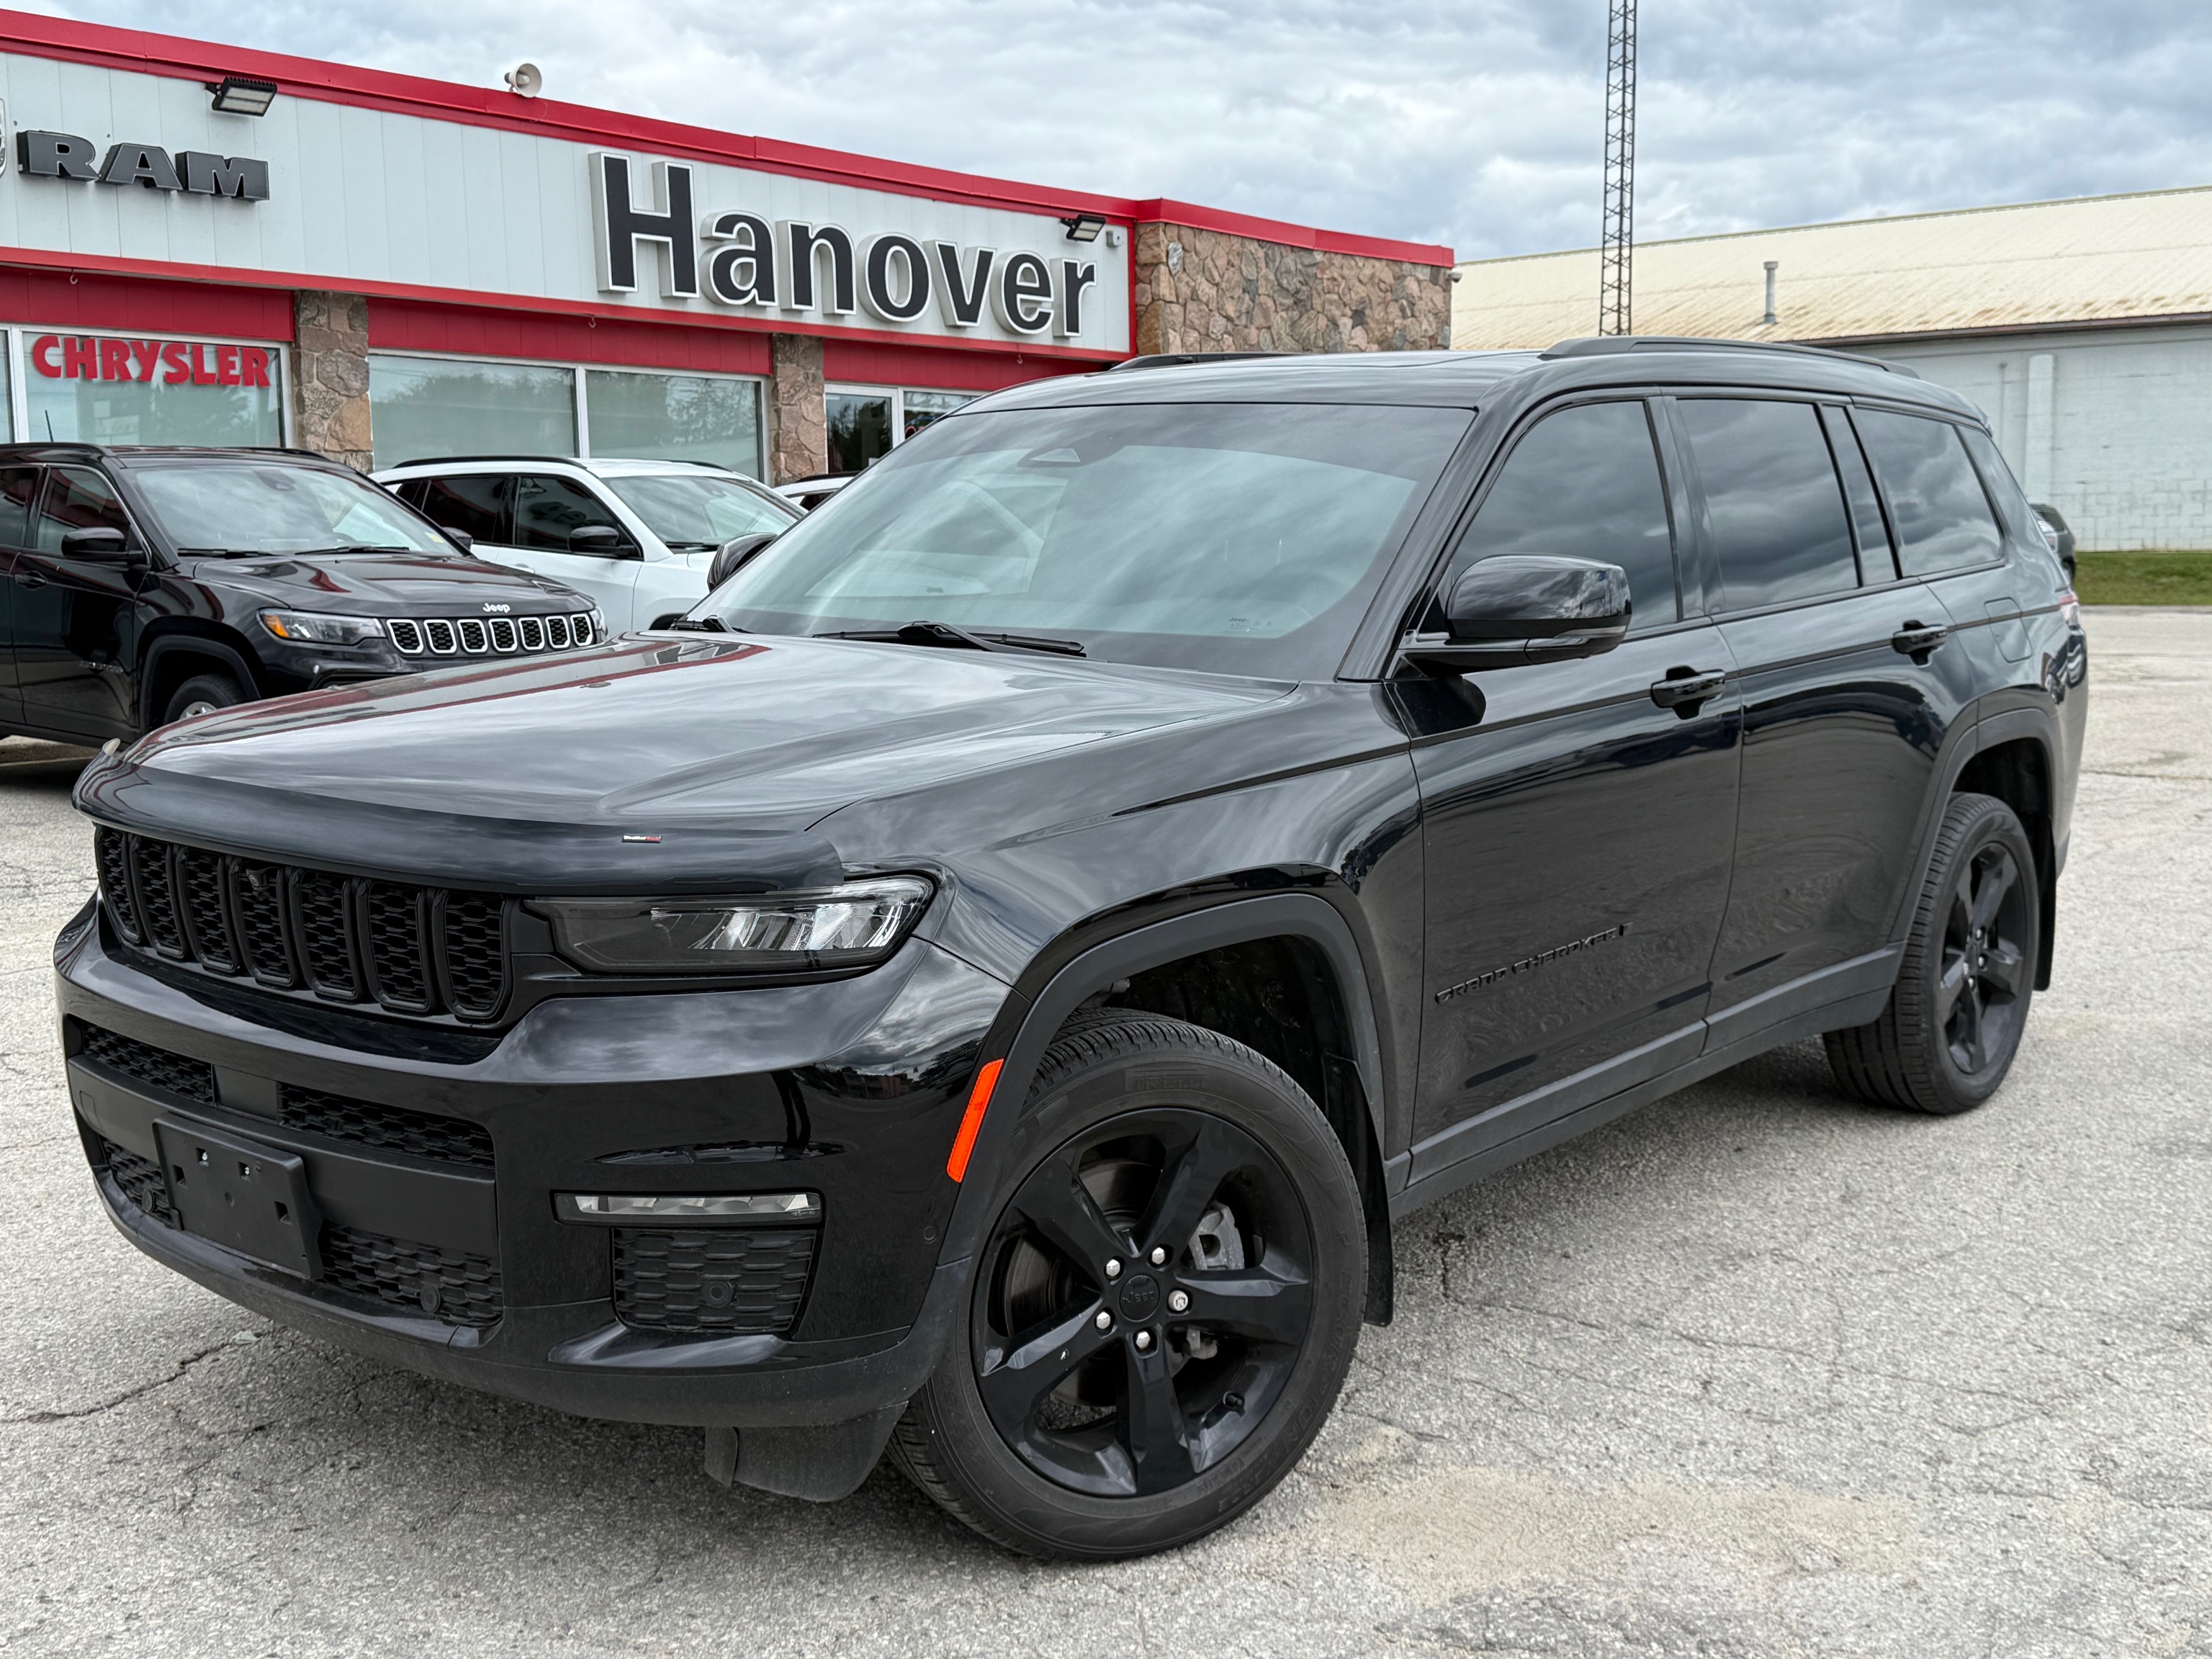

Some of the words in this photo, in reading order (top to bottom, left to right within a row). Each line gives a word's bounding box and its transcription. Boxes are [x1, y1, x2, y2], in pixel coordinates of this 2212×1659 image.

[17, 130, 270, 202] RAM
[588, 151, 1097, 338] Hanover
[32, 334, 271, 387] CHRYSLER
[482, 602, 511, 613] Jeep
[1434, 966, 1508, 1004] GRAND
[1511, 927, 1617, 974] CHEROKEE
